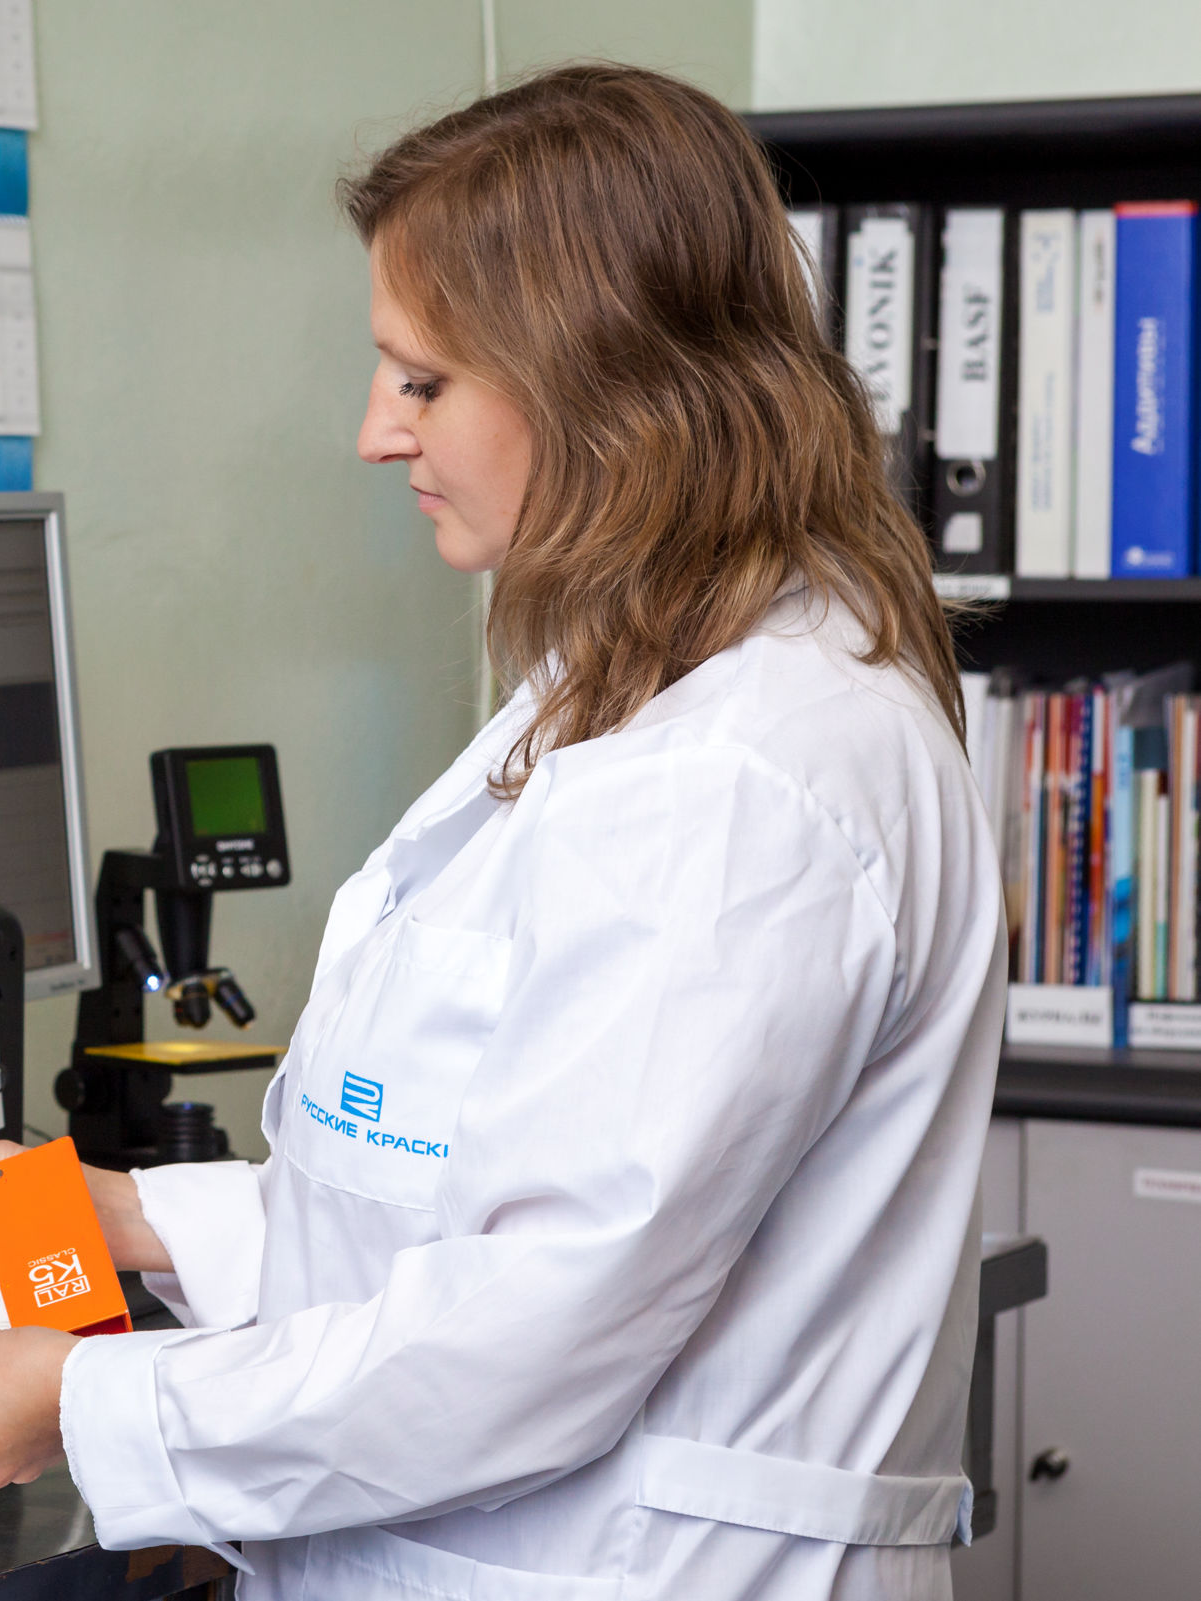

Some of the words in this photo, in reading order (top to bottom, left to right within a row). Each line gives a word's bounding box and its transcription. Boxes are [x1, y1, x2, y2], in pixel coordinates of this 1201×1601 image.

[962, 290, 991, 383] BASF
[301, 1094, 358, 1139] РУССКИЕ
[27, 1248, 76, 1268] CLASSIC
[29, 1254, 83, 1289] K5
[39, 1279, 87, 1301] RAL
